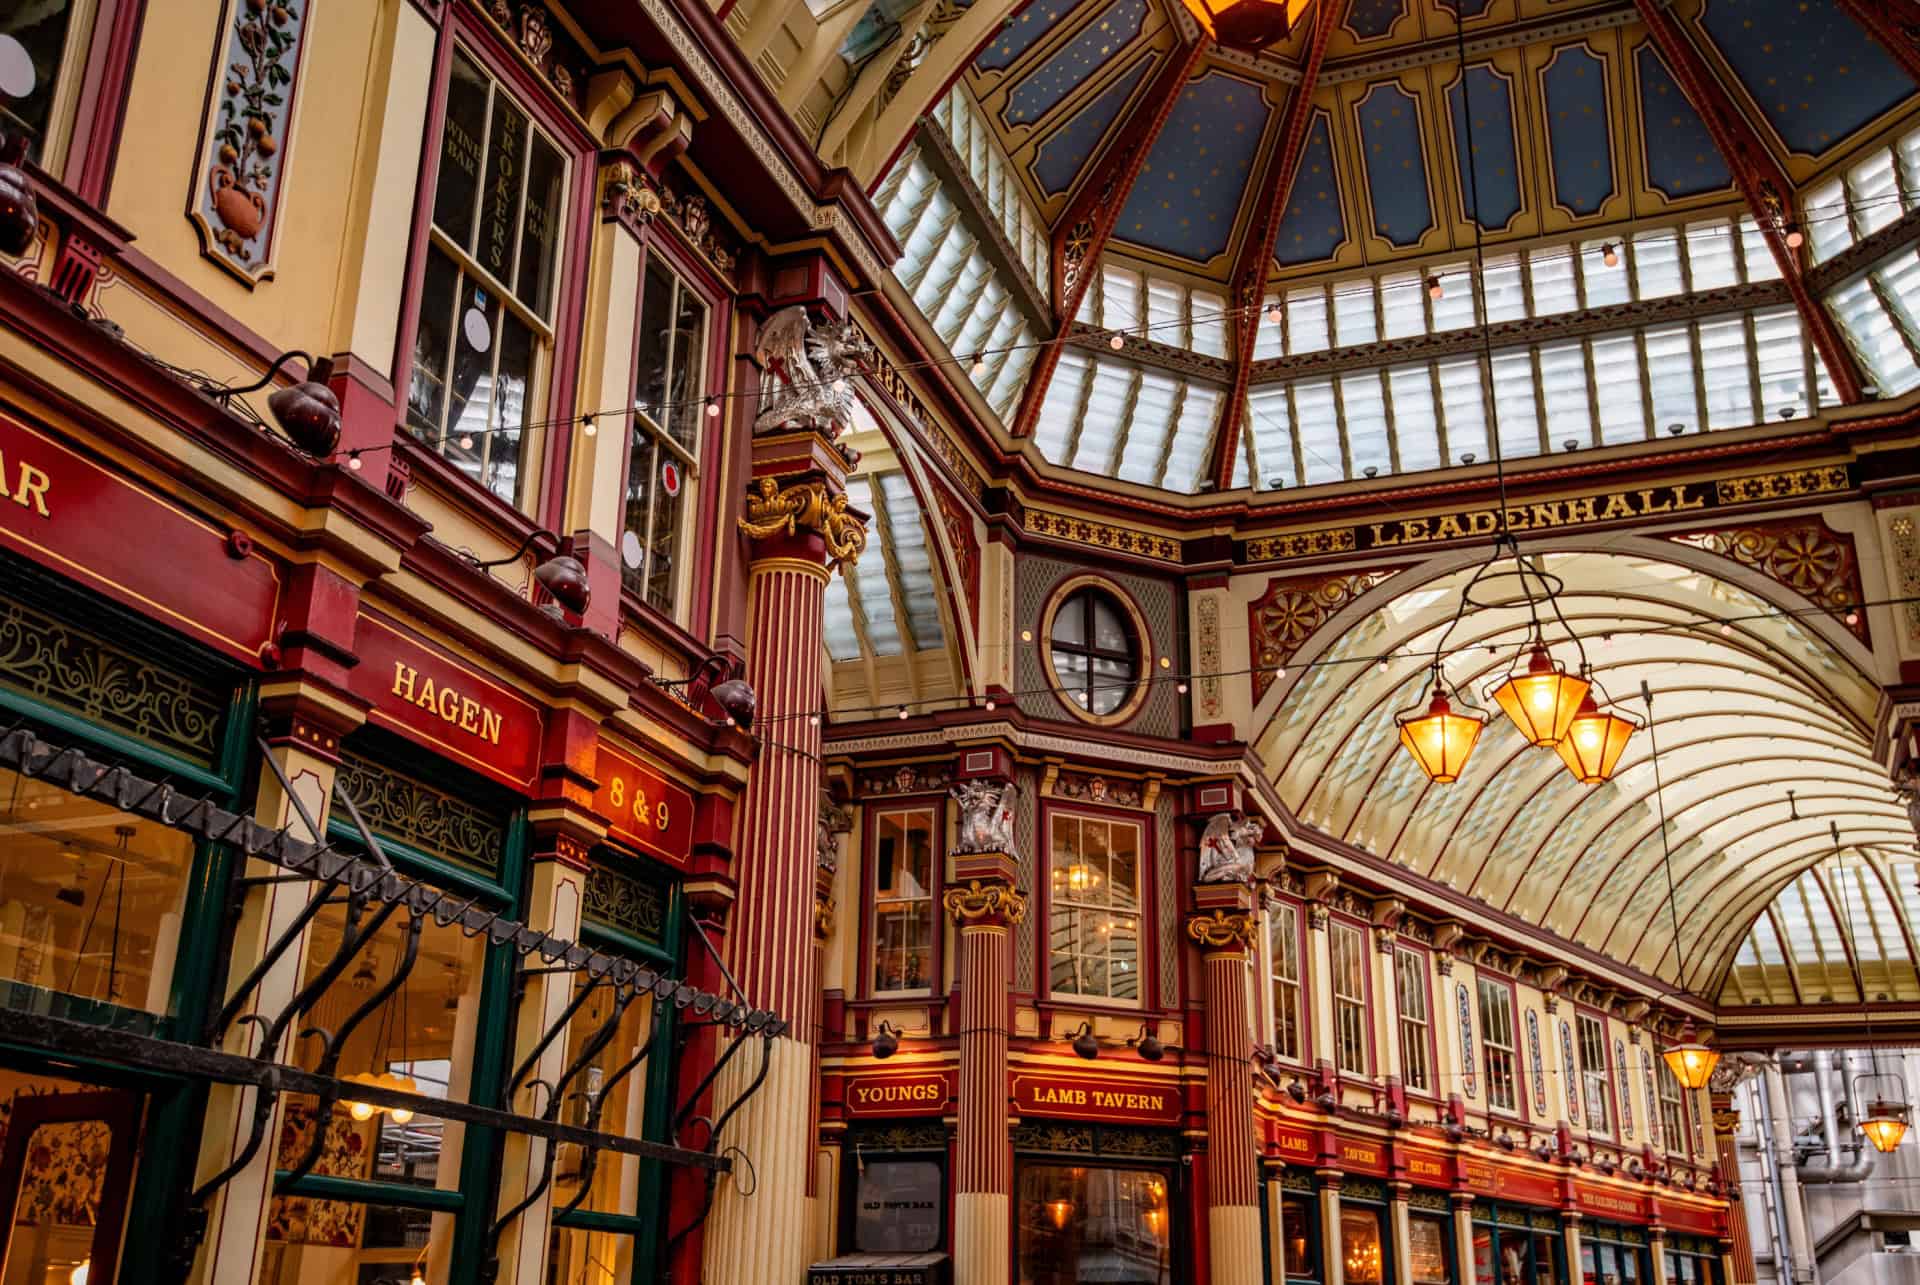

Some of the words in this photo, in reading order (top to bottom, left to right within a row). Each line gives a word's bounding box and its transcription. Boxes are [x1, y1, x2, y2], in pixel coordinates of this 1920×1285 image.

[1370, 486, 1705, 547] LEADENHALL
[391, 661, 502, 745] HAGEN
[610, 777, 624, 807] 8
[633, 789, 650, 825] &
[655, 801, 670, 832] 9
[857, 1084, 939, 1104] YOUNGS
[1033, 1086, 1086, 1105] LAMB
[1092, 1091, 1164, 1111] TAVERN
[1281, 1135, 1309, 1152] LAMB
[1343, 1146, 1377, 1164] TAVERN
[812, 1274, 840, 1285] OLD
[845, 1273, 888, 1285] TOM'S
[895, 1272, 923, 1285] BAR
